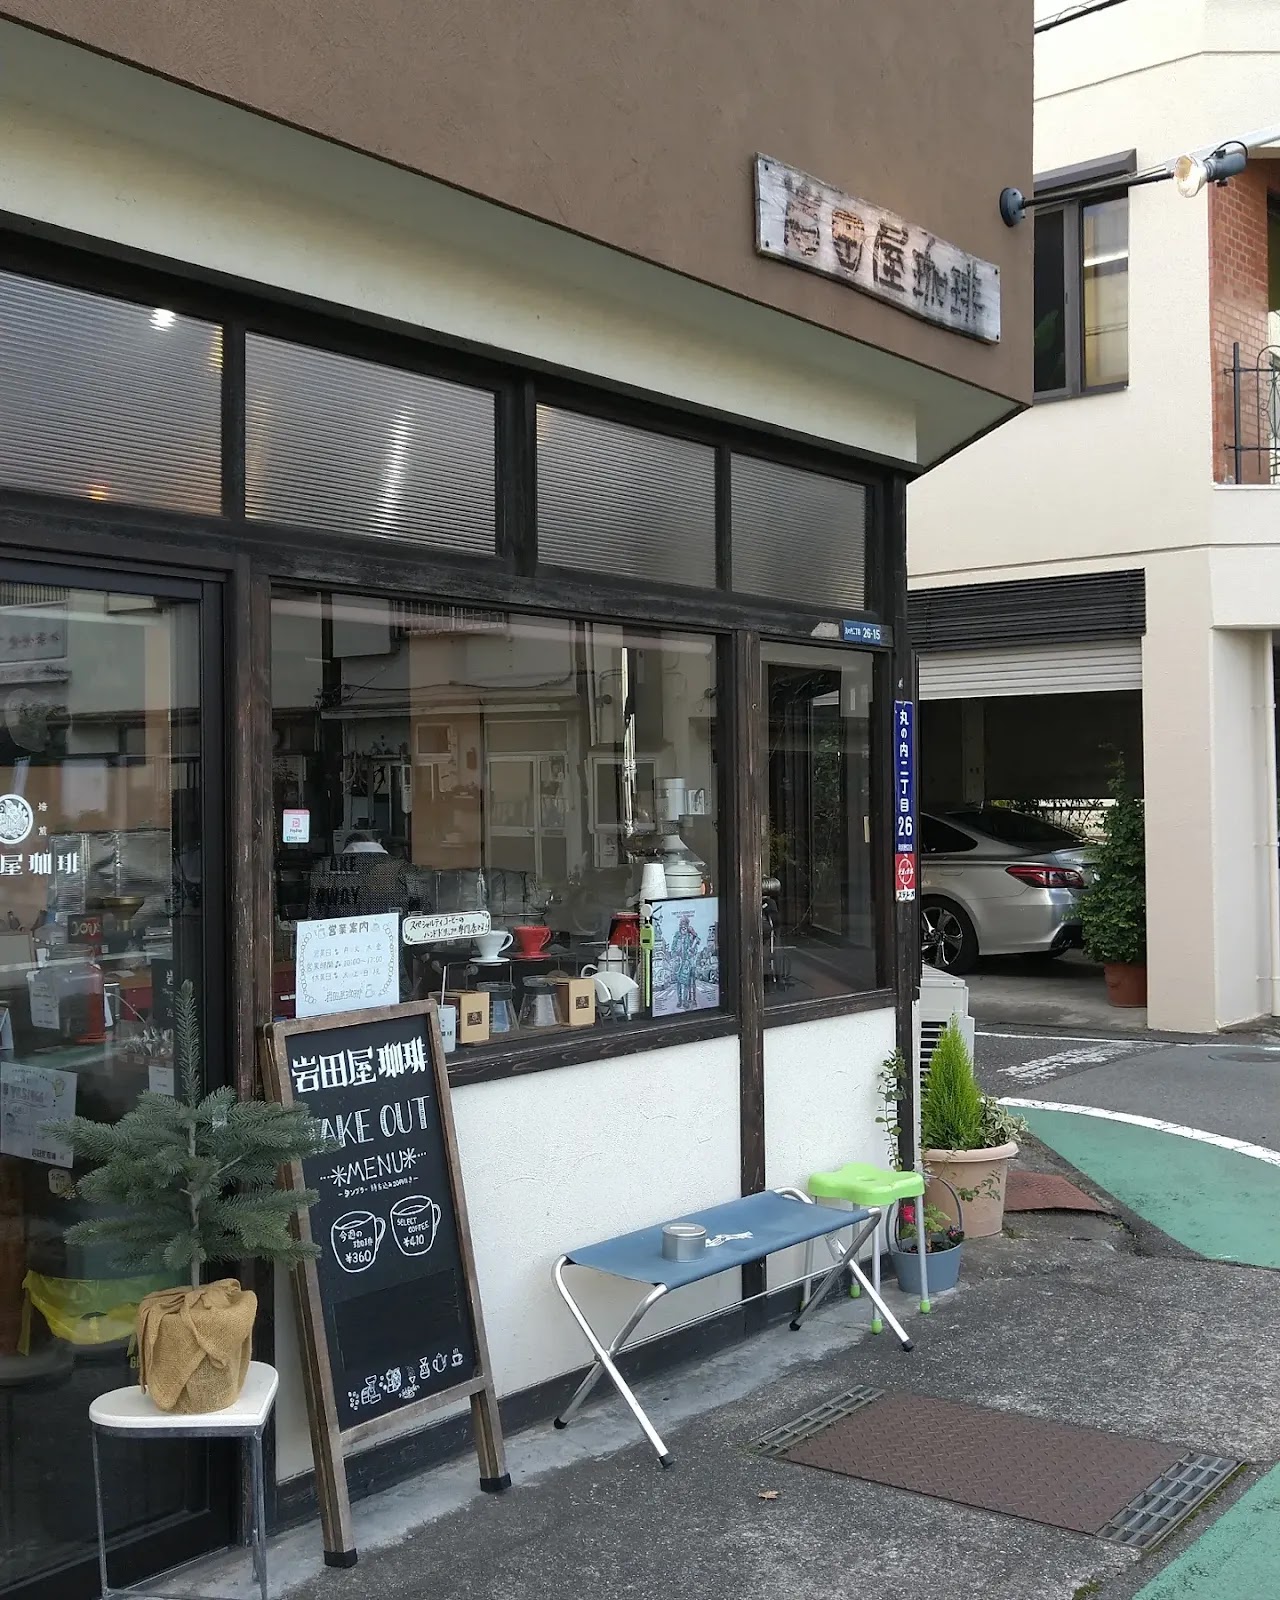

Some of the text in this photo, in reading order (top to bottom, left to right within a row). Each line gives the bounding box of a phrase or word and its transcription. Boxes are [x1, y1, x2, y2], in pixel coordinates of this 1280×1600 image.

[863, 627, 880, 640] 26-15
[898, 816, 913, 837] 26
[328, 921, 369, 937] 営業案内
[291, 1036, 428, 1094] 岩田屋珈琲
[320, 1096, 430, 1148] AKE OUT
[347, 1150, 404, 1185] MENU
[397, 1217, 418, 1227] SELECT
[408, 1220, 430, 1233] COFFEE
[403, 1234, 425, 1247] ¥410
[345, 1250, 372, 1264] ¥360
